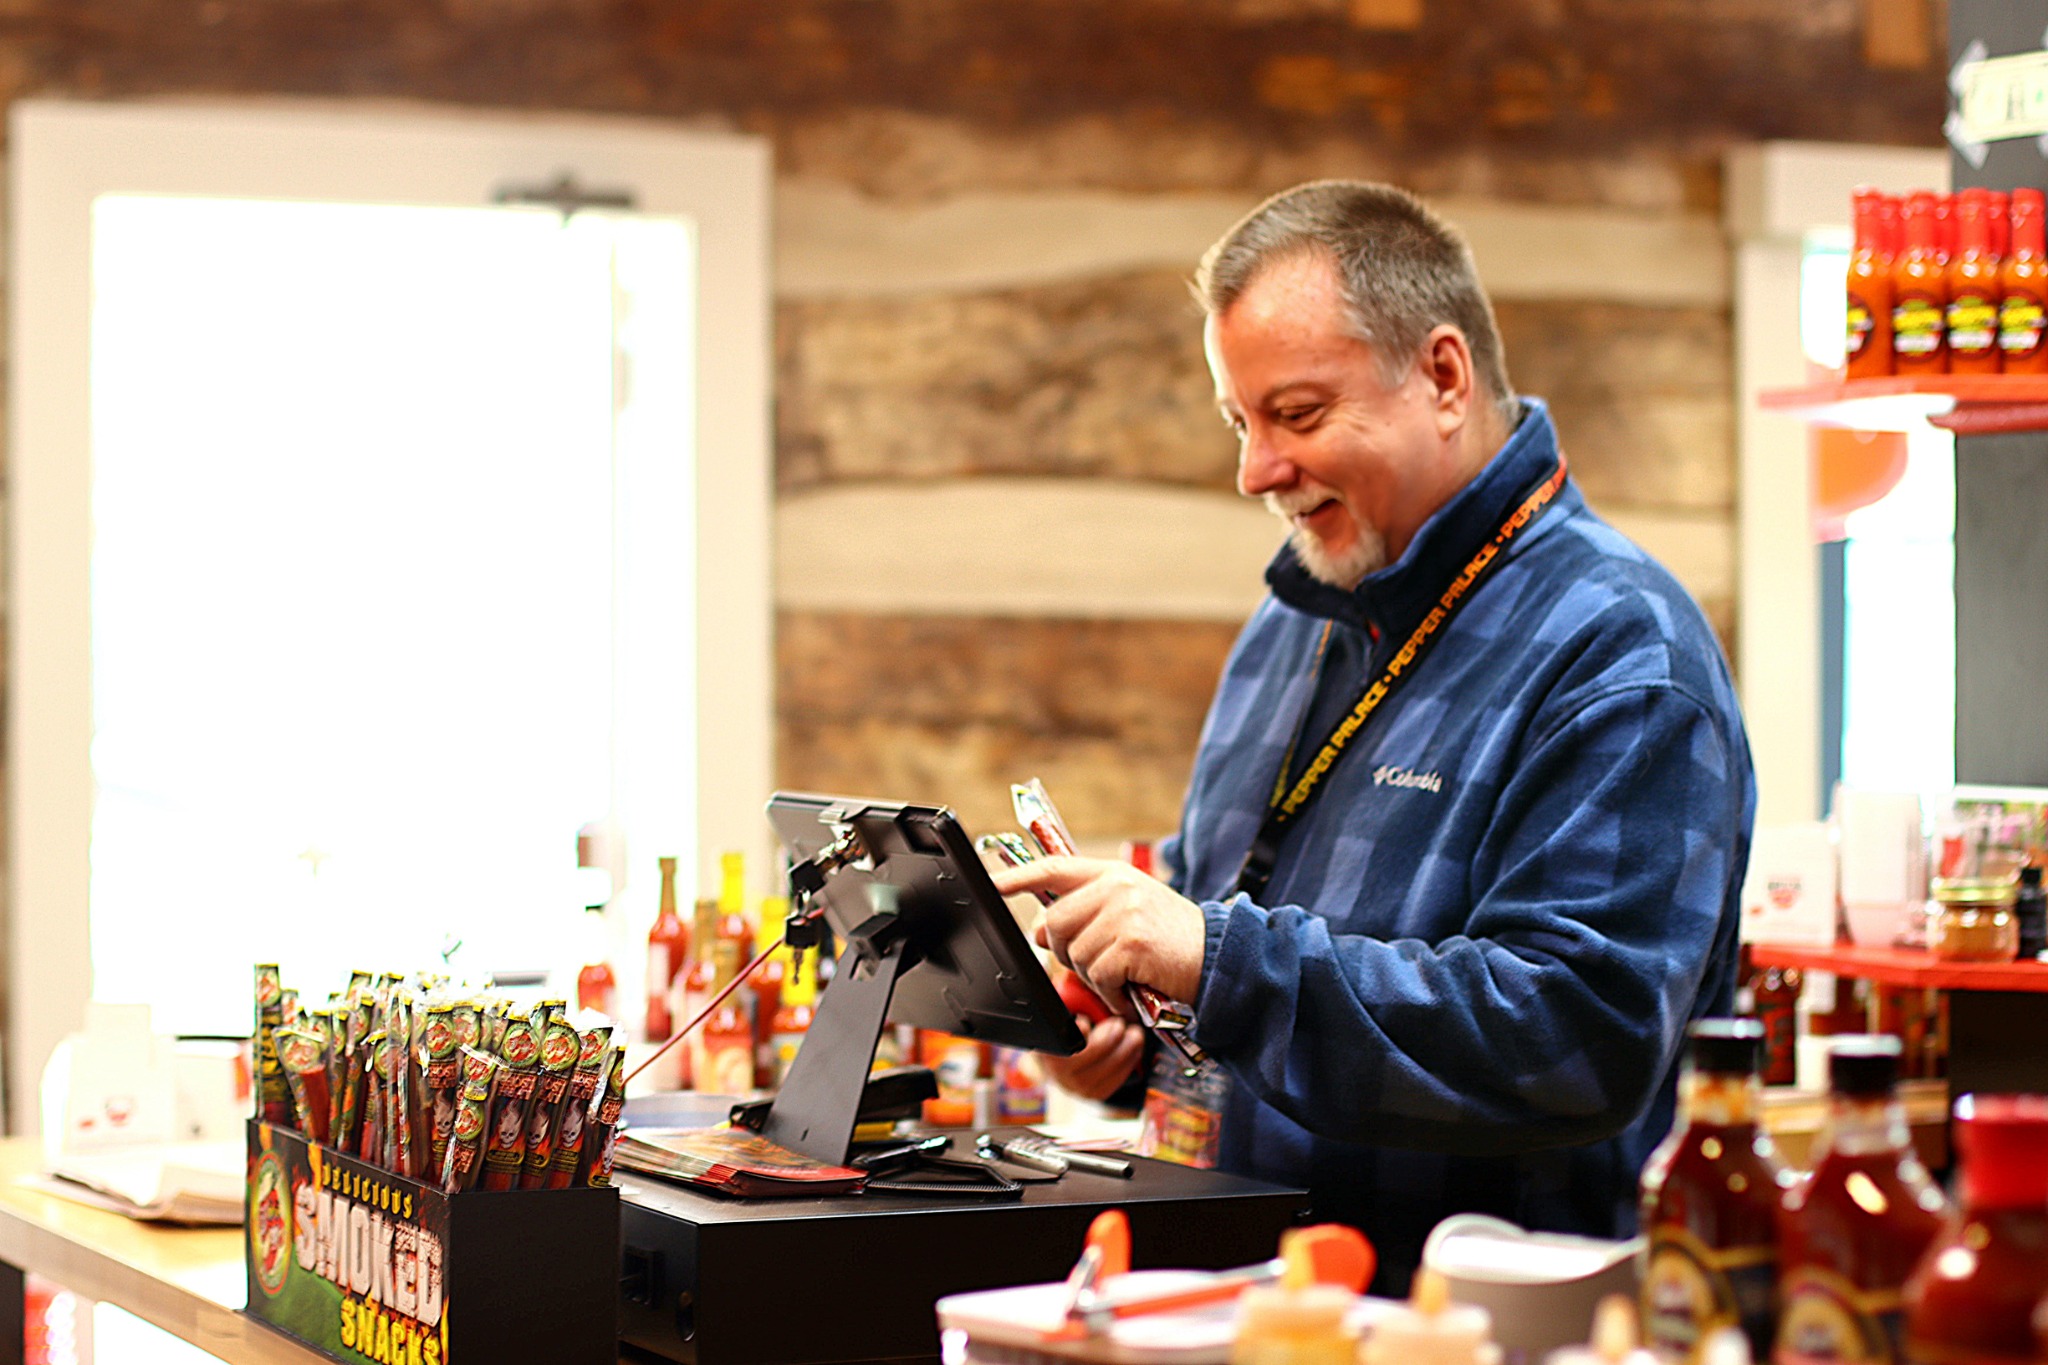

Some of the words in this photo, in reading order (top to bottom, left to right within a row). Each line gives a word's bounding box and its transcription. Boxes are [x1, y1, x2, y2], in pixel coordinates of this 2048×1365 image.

[1281, 744, 1340, 815] PEPPER
[1330, 679, 1390, 749] PALACE
[1387, 605, 1448, 677] PEPPER
[1439, 541, 1500, 610] PALACE
[1385, 766, 1443, 793] Columbia
[321, 1161, 414, 1220] DELICIOUS
[295, 1182, 443, 1328] SMOKED
